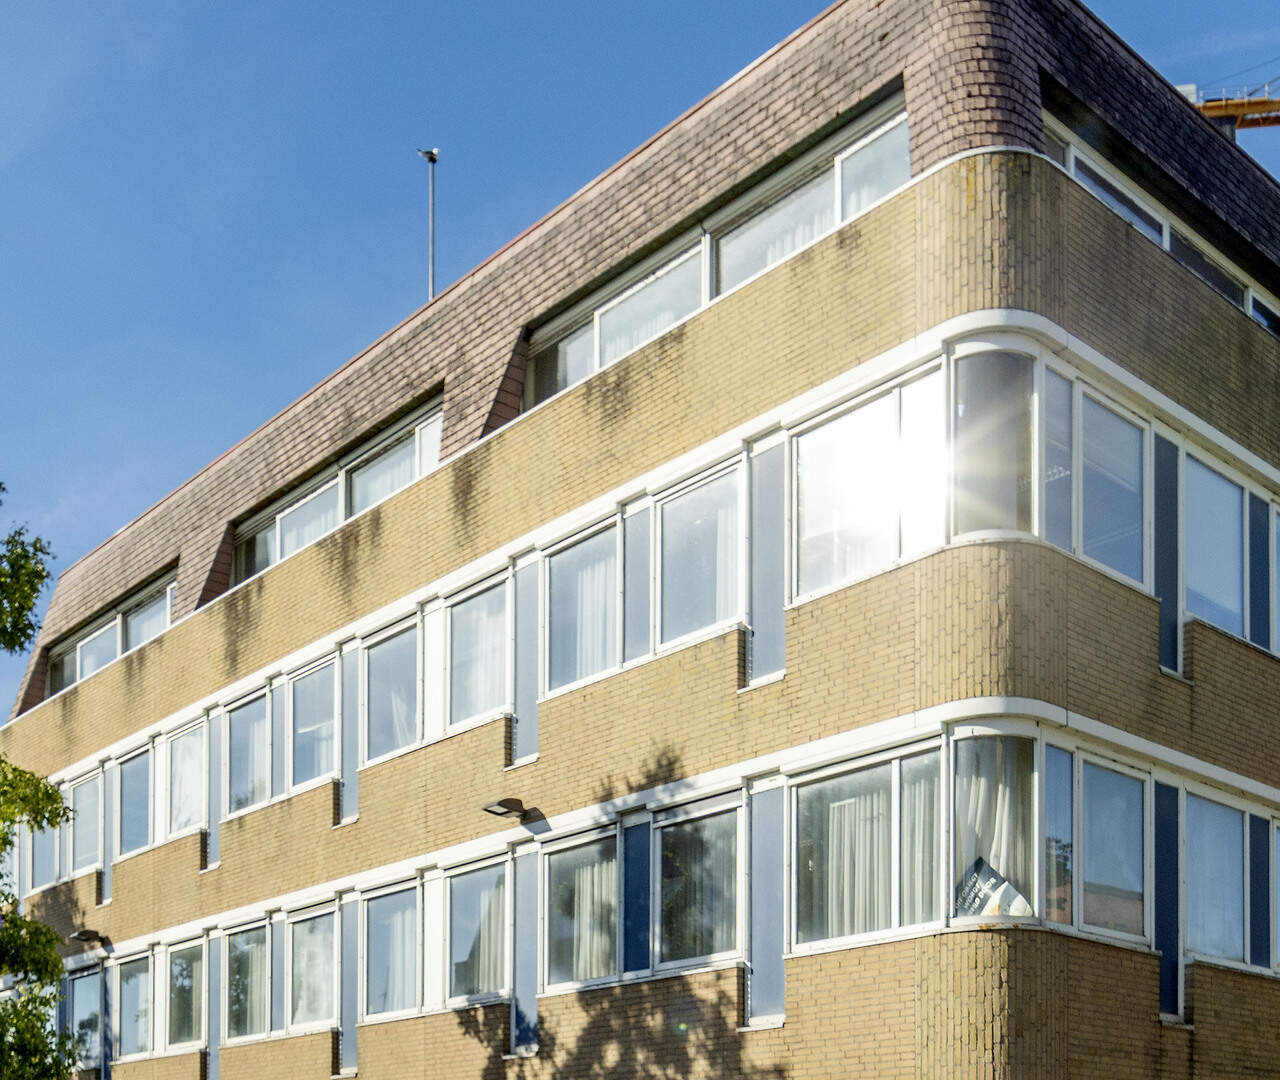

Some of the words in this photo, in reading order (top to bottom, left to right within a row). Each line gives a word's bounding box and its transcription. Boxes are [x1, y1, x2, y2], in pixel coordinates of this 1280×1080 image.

[961, 872, 978, 897] OBJECT
[964, 882, 980, 909] WORDT
[978, 877, 997, 899] DOOR
